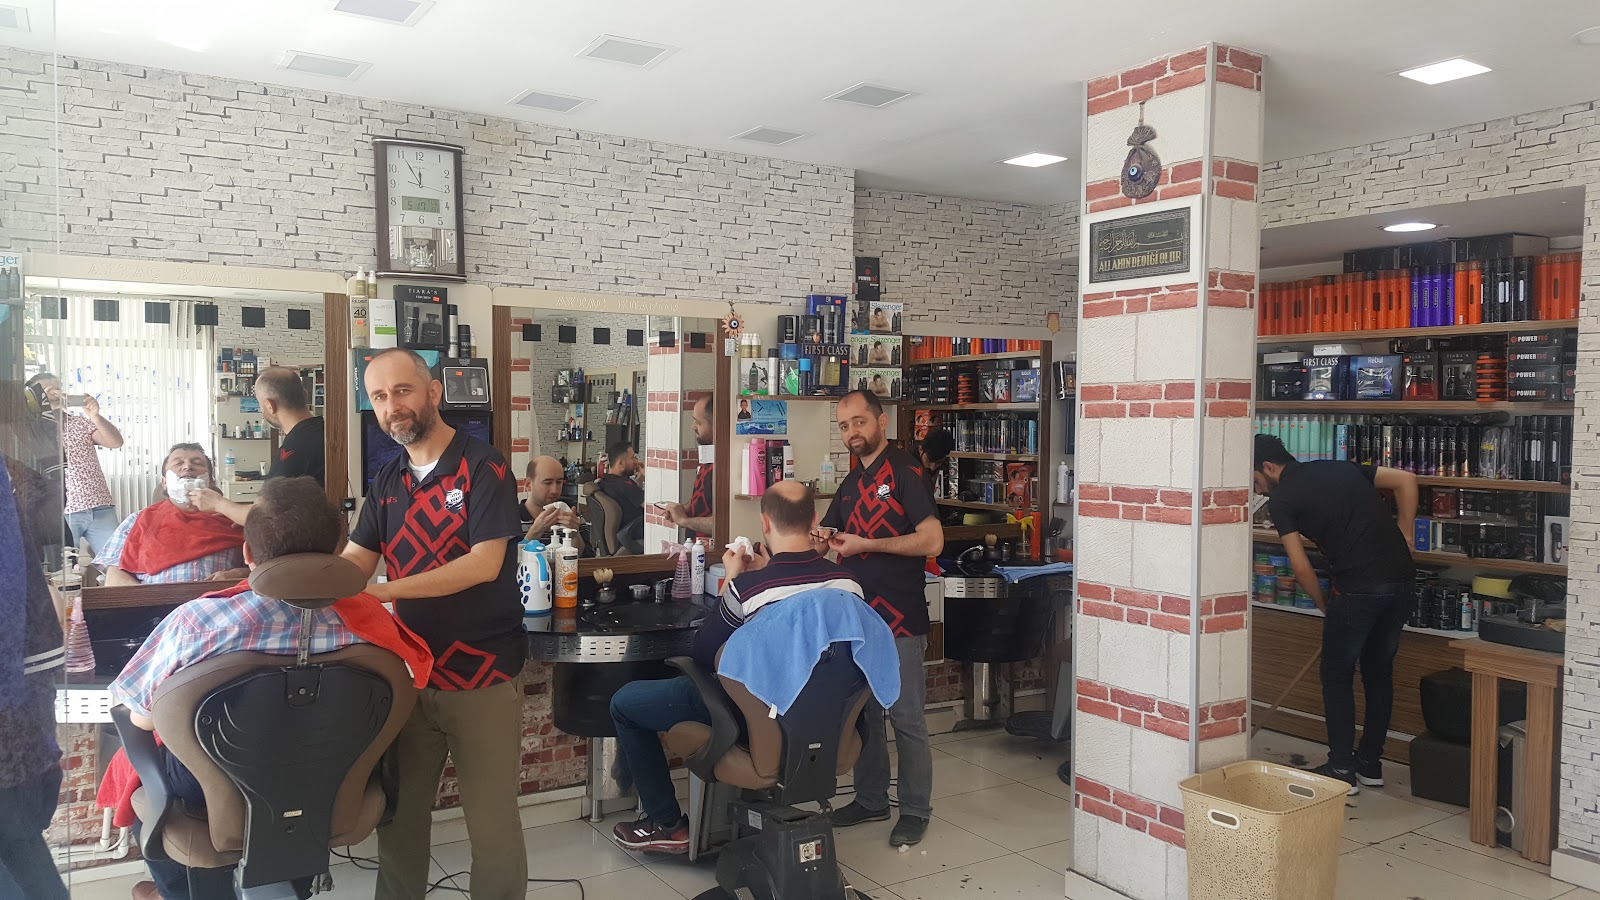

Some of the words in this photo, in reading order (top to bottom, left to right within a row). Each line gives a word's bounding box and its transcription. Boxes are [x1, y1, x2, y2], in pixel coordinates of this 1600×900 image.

[397, 149, 405, 160] 11
[415, 151, 424, 161] 12
[388, 163, 397, 173] 10
[443, 169, 450, 179] 2
[389, 178, 396, 189] 9
[444, 184, 451, 194] 3
[390, 196, 397, 206] 8
[444, 201, 450, 211] 4
[399, 213, 406, 223] 7
[418, 214, 425, 225] 6
[437, 216, 444, 226] 5
[1099, 258, 1132, 272] ALLAHIN
[1160, 251, 1181, 264] OLUR
[408, 288, 438, 296] TIARA'S
[870, 302, 902, 311] Slazenger
[353, 308, 367, 317] 40
[870, 335, 901, 344] Slazenger
[1517, 335, 1549, 343] POWERTEC
[804, 345, 826, 355] FIRST
[827, 345, 849, 356] CLASS
[1303, 358, 1320, 367] FIRST
[1320, 357, 1339, 366] CLASS
[1367, 356, 1384, 364] Rebul
[869, 368, 900, 377] Slazenger
[1516, 389, 1547, 397] POWERTEC
